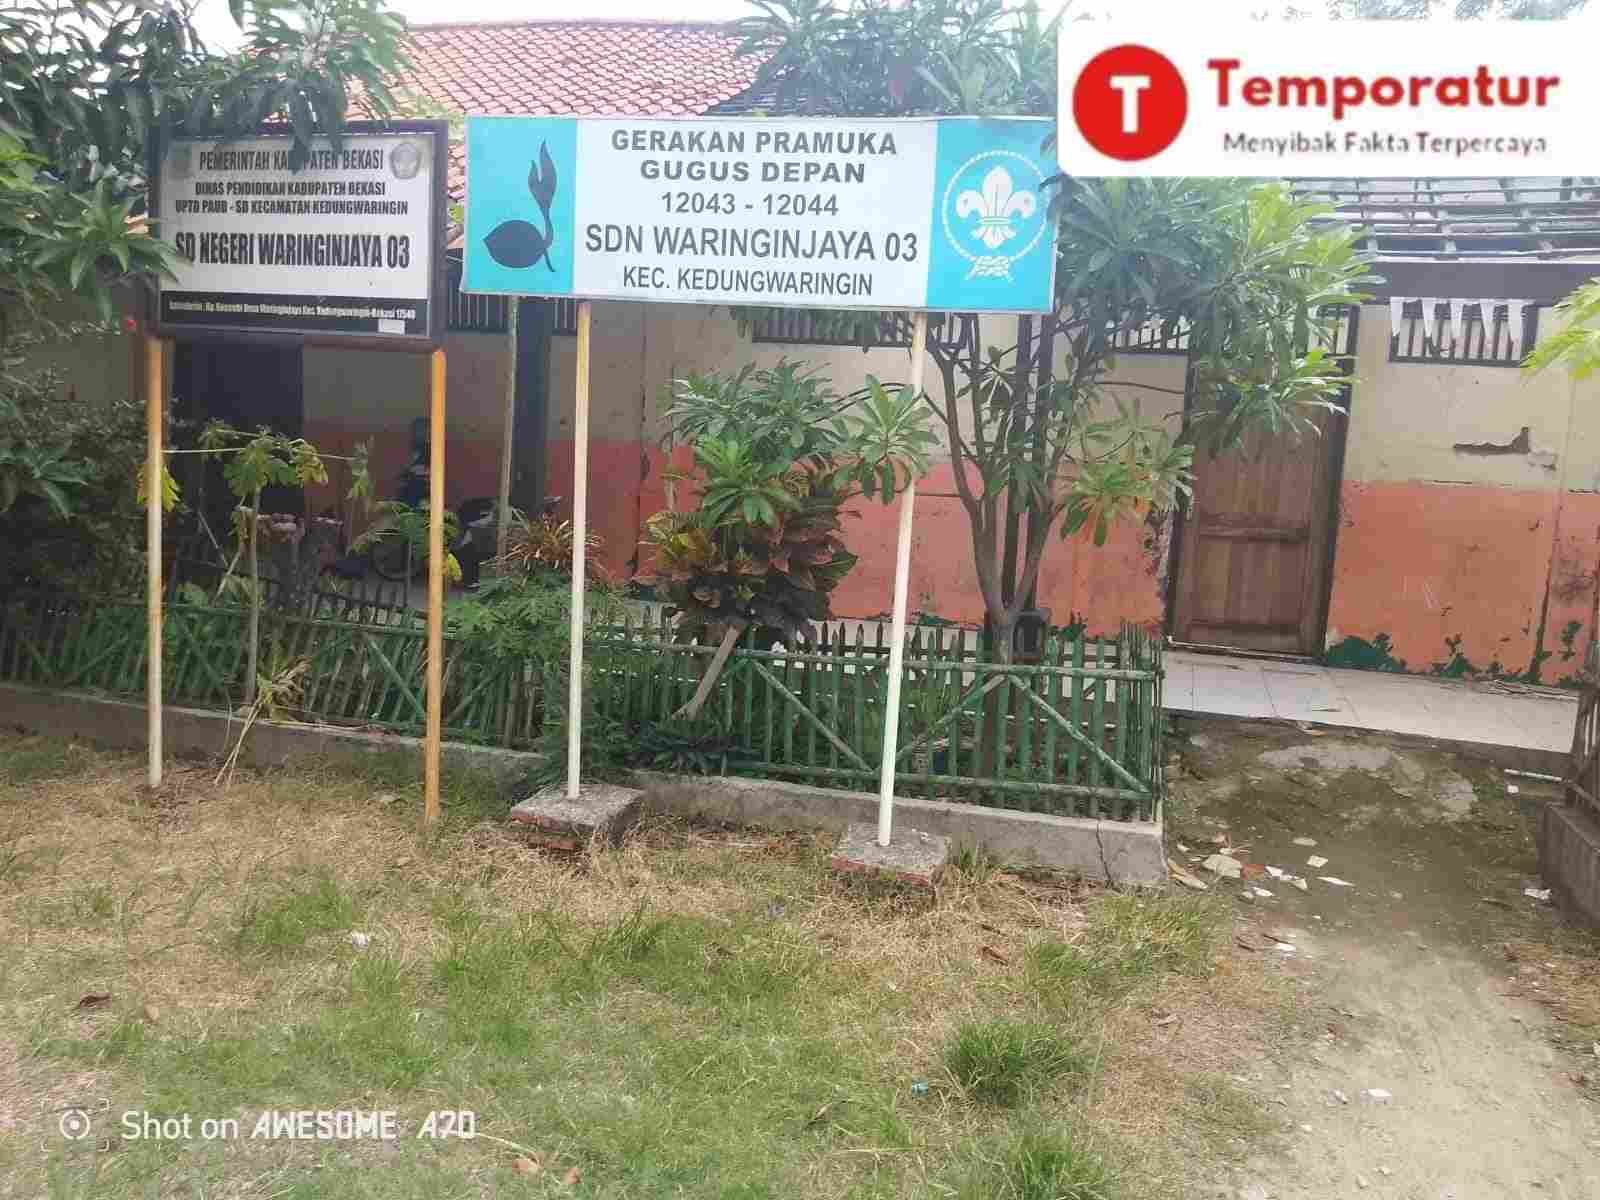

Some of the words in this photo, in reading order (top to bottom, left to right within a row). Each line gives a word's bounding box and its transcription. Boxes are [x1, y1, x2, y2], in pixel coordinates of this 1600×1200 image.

[611, 130, 746, 152] GERAKAN
[755, 132, 897, 155] PRAMUKA
[199, 150, 270, 171] PEMERINTAH
[273, 150, 338, 171] KAPATEN
[343, 149, 384, 170] BEKASI
[640, 160, 750, 182] GUGUS
[761, 162, 865, 183] DEPAN
[195, 182, 224, 196] DINAS
[226, 182, 285, 196] PENDIDIKAN
[288, 182, 346, 196] KABUPATEN
[348, 182, 386, 196] BEKASI
[236, 200, 249, 214] SD
[251, 200, 311, 214] KECAMATAN
[313, 201, 408, 215] KEDUNGWARINGIN
[662, 192, 736, 215] 12043
[763, 194, 839, 216] 12044
[176, 232, 196, 263] SD
[199, 232, 254, 264] NEGERI
[257, 233, 383, 267] WARINGINJAYA
[387, 235, 411, 269] 03
[585, 224, 643, 253] SDN
[654, 226, 876, 261] WARINGINJAYA
[885, 232, 918, 262] 03
[623, 266, 671, 289] KEC.
[677, 268, 873, 296] KEDUNGWARINGIN
